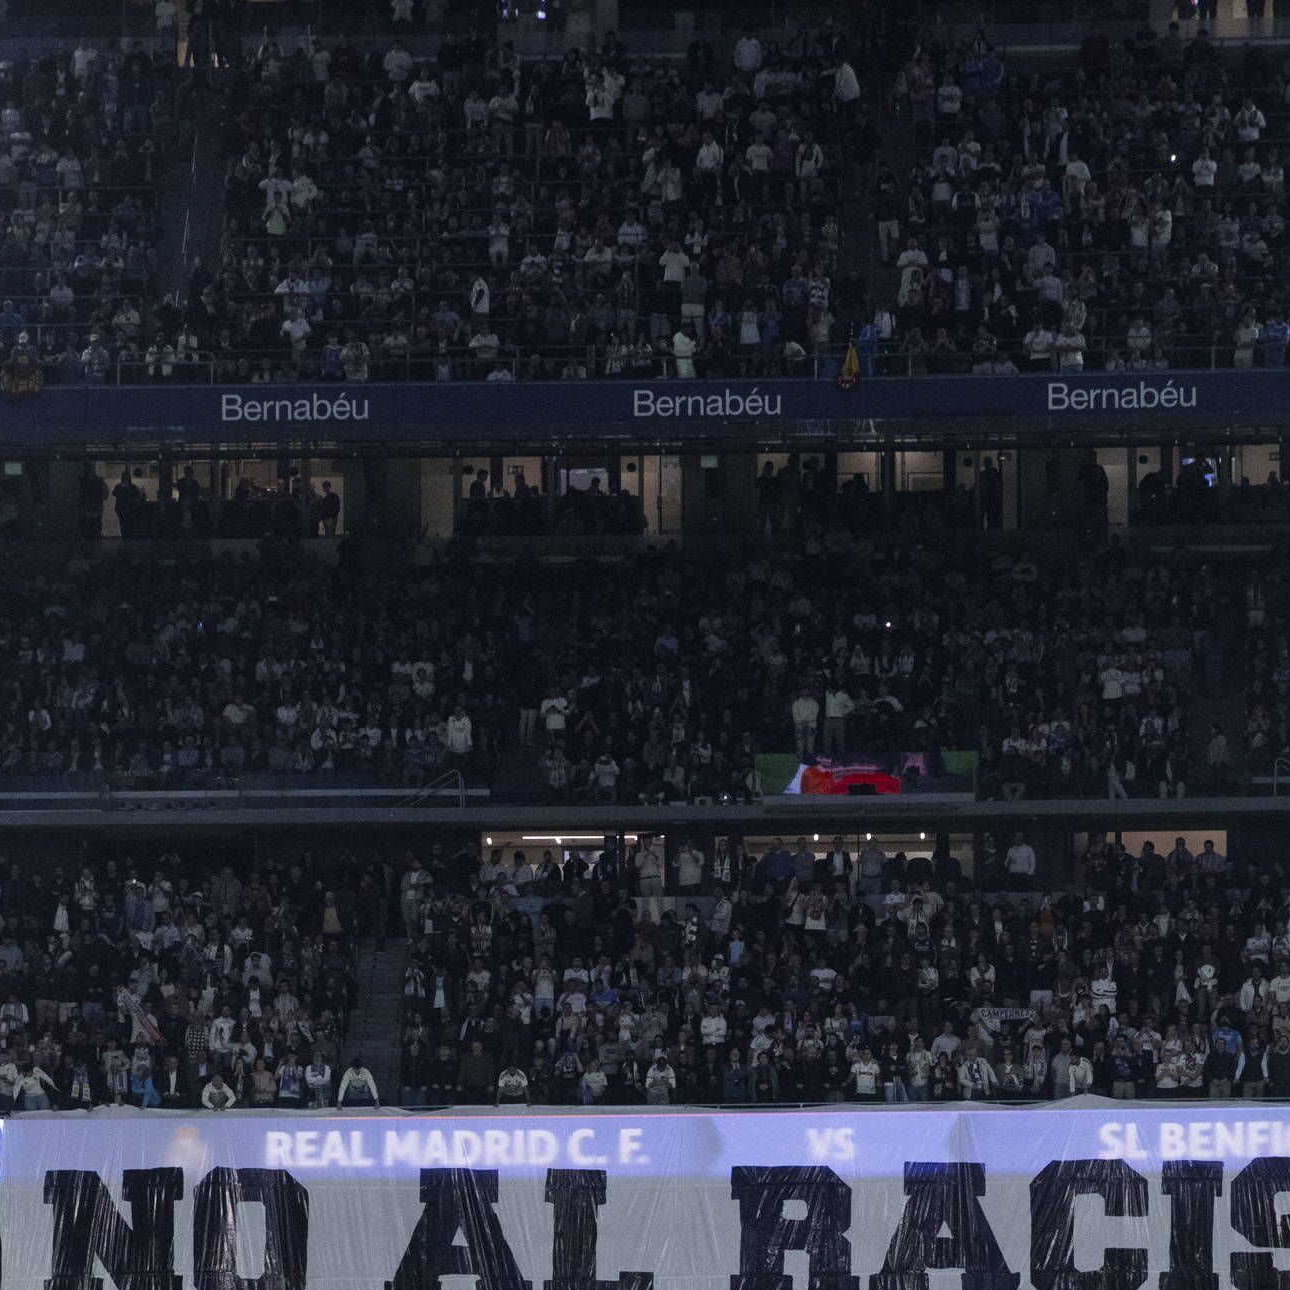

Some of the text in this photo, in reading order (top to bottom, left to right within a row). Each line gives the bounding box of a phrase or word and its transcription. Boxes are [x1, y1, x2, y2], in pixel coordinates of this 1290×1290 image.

[222, 392, 369, 421] Bernabéu
[633, 387, 782, 416] Bernabéu
[1048, 380, 1197, 410] Bernabéu
[266, 1129, 371, 1167] REAL
[385, 1127, 557, 1166] MADRID
[808, 1127, 854, 1161] VS
[1098, 1122, 1149, 1159] SL
